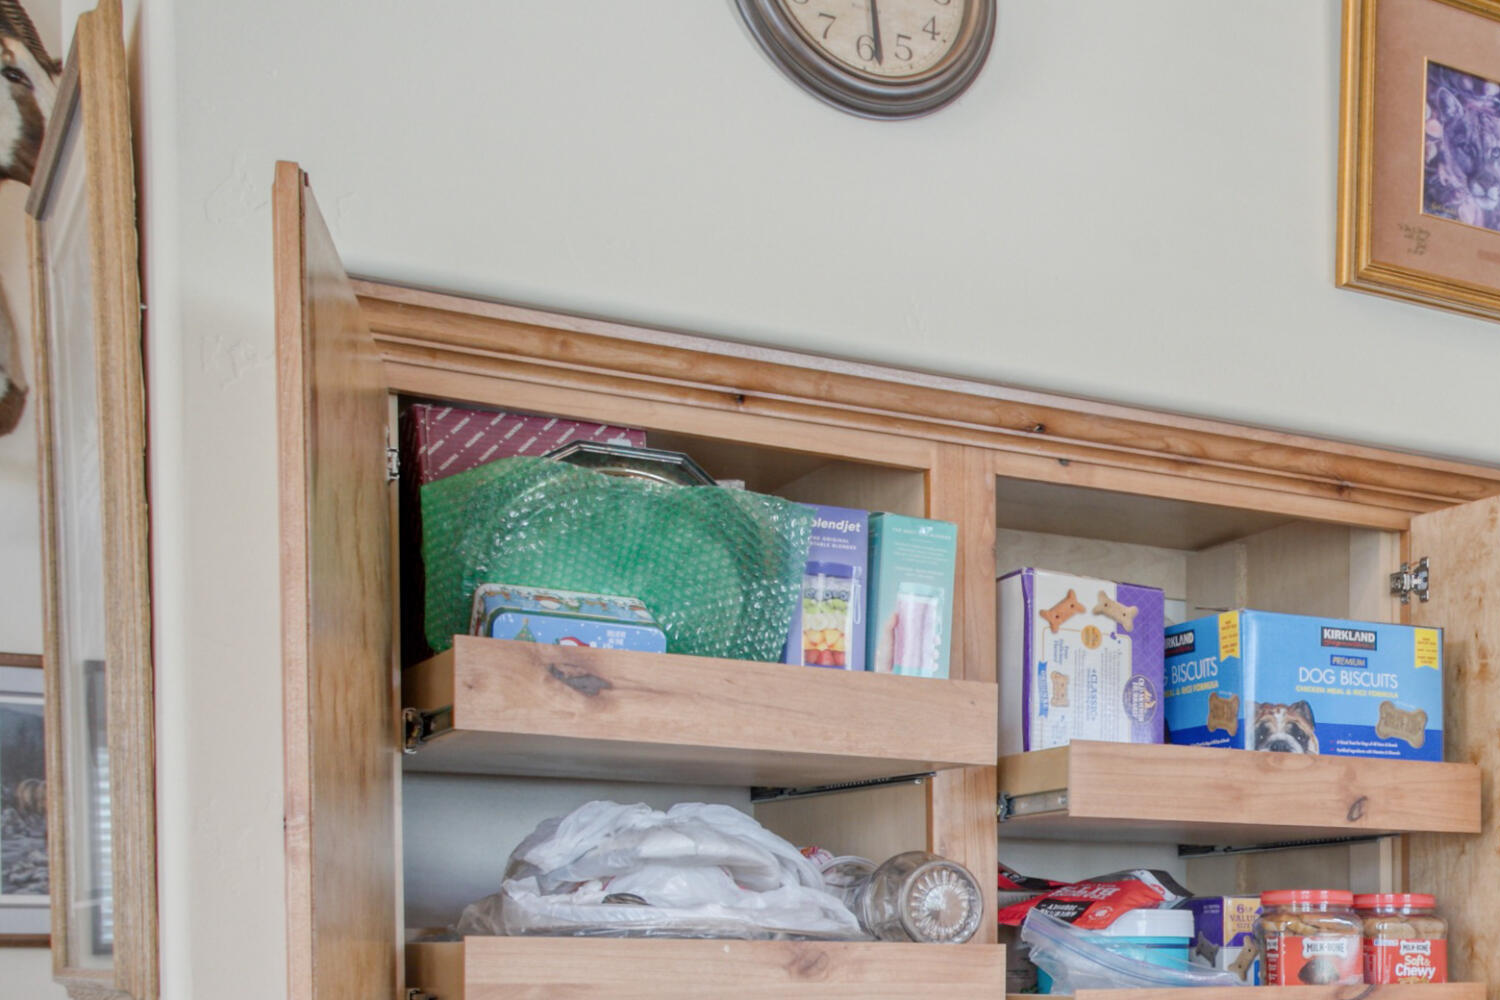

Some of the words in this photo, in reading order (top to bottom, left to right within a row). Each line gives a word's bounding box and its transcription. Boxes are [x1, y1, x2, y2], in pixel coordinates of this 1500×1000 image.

[817, 12, 837, 40] 7
[922, 16, 941, 41] 4
[856, 35, 876, 62] 6
[894, 34, 914, 62] 5
[1323, 628, 1376, 642] KIRKLAND
[1171, 656, 1218, 684] BISCUITS
[1332, 657, 1366, 666] PREMIUM
[1298, 667, 1336, 684] DOG
[1340, 671, 1399, 689] BISCUITS
[1395, 964, 1436, 980] Chewy
[1404, 955, 1424, 967] Soft
